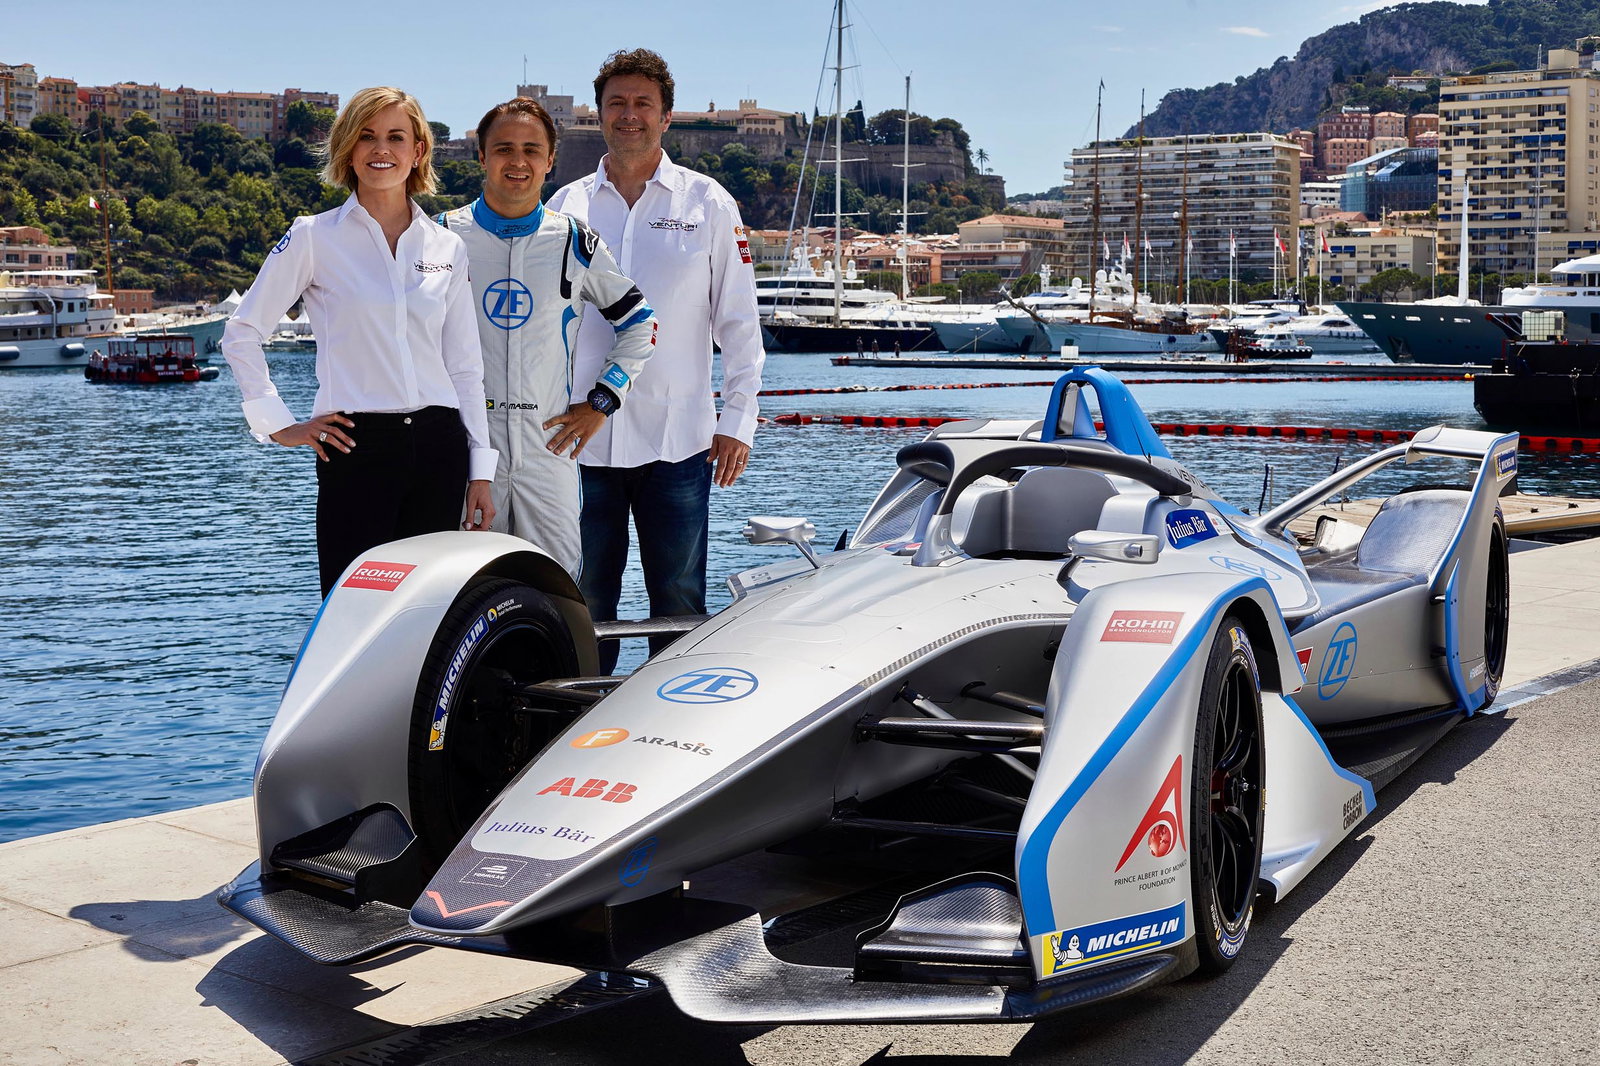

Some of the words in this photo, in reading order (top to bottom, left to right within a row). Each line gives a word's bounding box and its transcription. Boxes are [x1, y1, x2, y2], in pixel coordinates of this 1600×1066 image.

[648, 221, 698, 230] VENTURI
[485, 287, 531, 321] ZF
[1166, 520, 1195, 544] Julius
[1190, 516, 1208, 533] Bär
[352, 575, 399, 584] SEMICONDUCTOR
[355, 568, 406, 580] ROHM
[496, 598, 515, 612] MICHELIN
[1110, 619, 1176, 630] ROHM
[438, 618, 485, 711] MICHELIN
[1321, 635, 1357, 688] ZF
[661, 672, 757, 701] ZF
[536, 777, 638, 803] ABB
[1342, 790, 1363, 817] BECKER
[1342, 803, 1363, 831] CARBON
[483, 821, 548, 835] Julius
[552, 826, 596, 843] Bär
[1114, 875, 1136, 886] PRINCE
[1137, 870, 1158, 881] ALBERT
[1164, 866, 1172, 875] OF
[1138, 875, 1176, 891] FOUNDATION
[1086, 917, 1180, 953] MICHELIN
